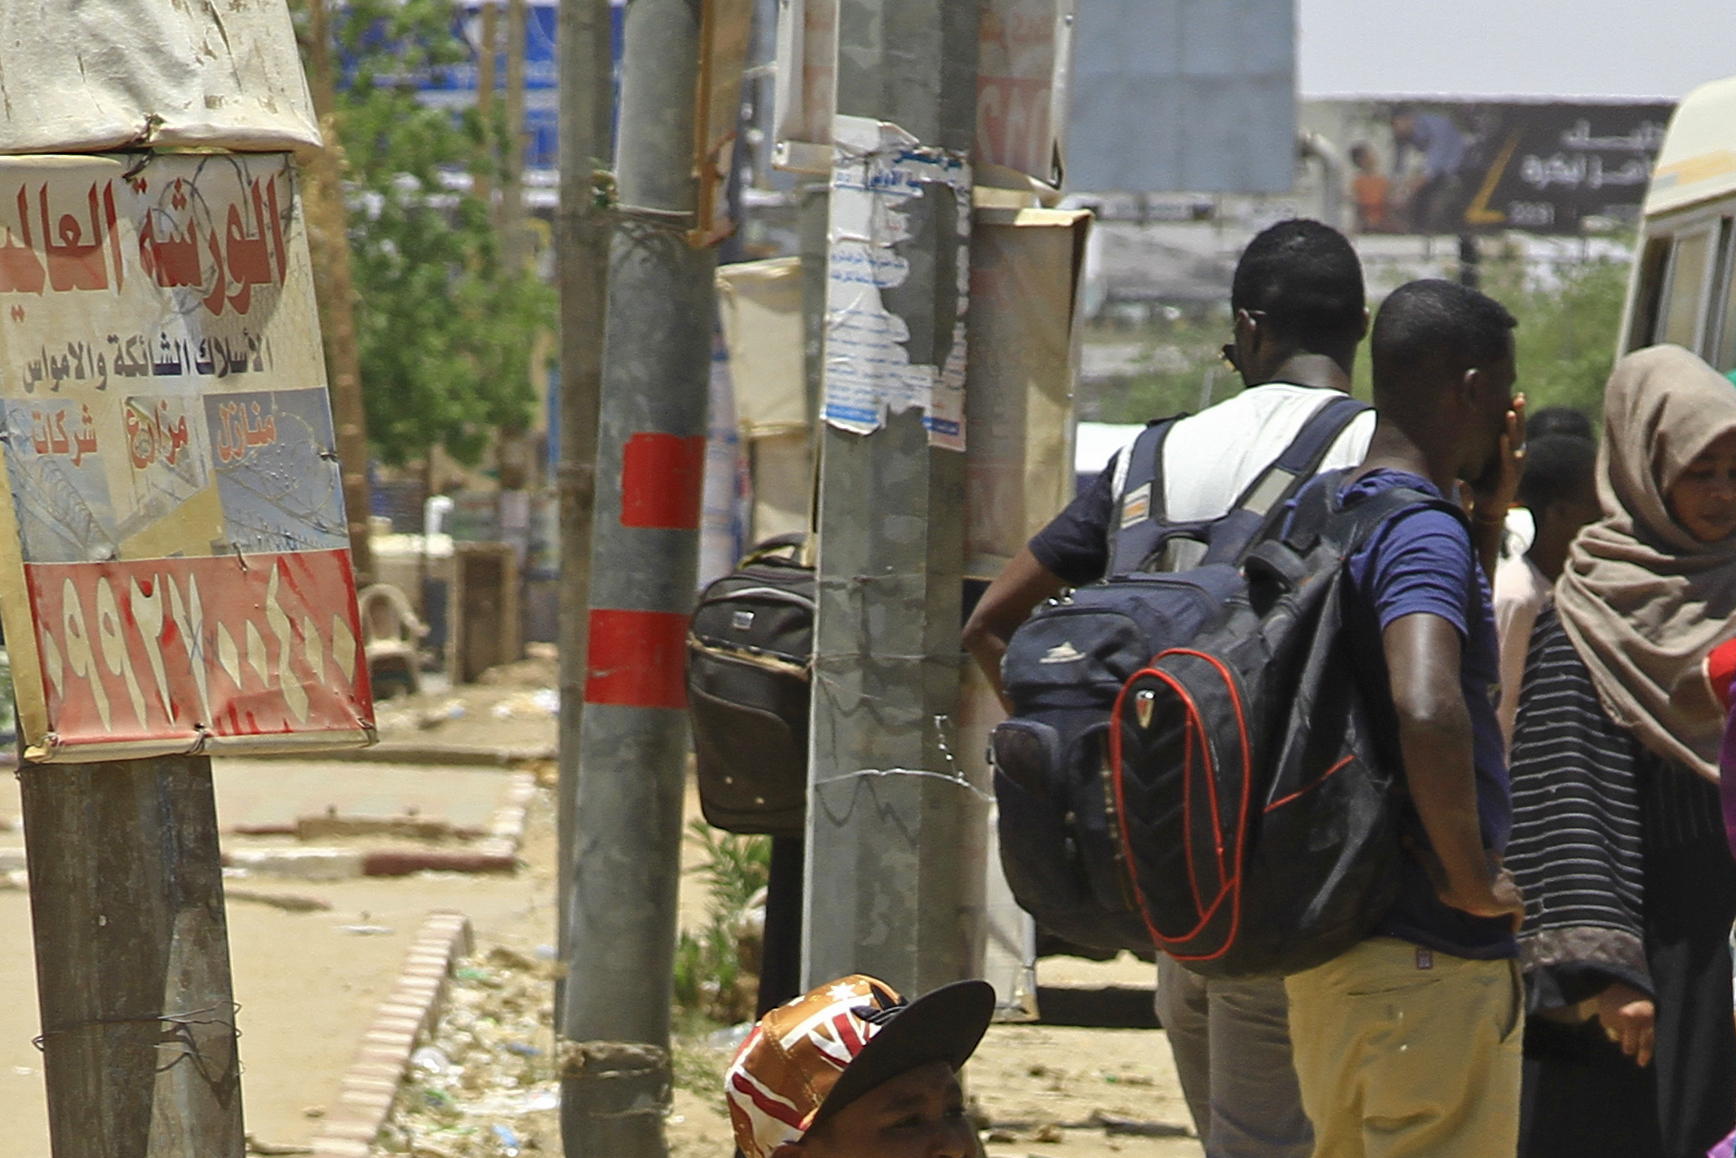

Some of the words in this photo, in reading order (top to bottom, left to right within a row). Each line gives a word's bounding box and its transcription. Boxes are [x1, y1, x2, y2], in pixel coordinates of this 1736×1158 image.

[0, 176, 125, 324] العالمي
[138, 174, 287, 317] الورشة
[106, 331, 192, 377] الشائكة
[31, 402, 99, 468] شركات
[217, 400, 278, 464] منازل
